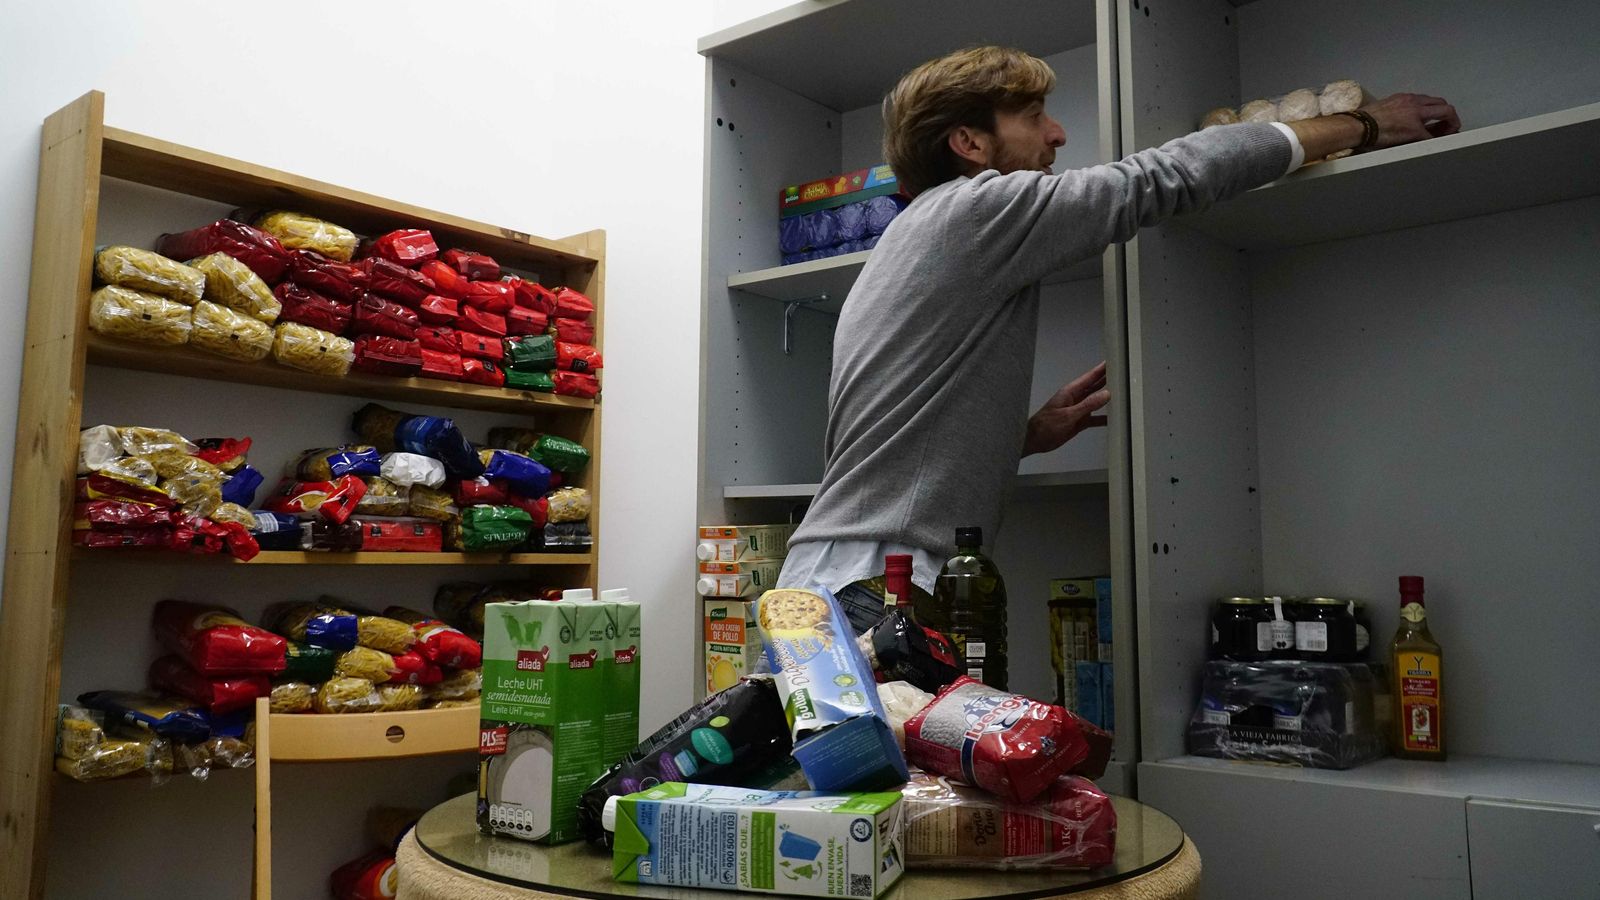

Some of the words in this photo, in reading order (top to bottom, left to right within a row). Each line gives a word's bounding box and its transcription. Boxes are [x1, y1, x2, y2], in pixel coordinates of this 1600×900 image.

[713, 631, 721, 640] DE
[722, 632, 739, 641] POLLO
[517, 656, 542, 671] aliada
[569, 658, 590, 669] aliada
[497, 677, 524, 691] Leche
[526, 678, 543, 691] UHT
[486, 688, 552, 706] semidesnatada
[795, 688, 814, 721] gullón
[491, 704, 508, 715] Leite
[509, 706, 523, 716] UHT
[481, 731, 497, 747] PLS
[1241, 731, 1264, 739] VIEJA
[1266, 733, 1302, 743] FABRICA
[727, 815, 736, 831] 103
[727, 832, 736, 850] 500
[727, 852, 736, 868] 900
[835, 845, 845, 866] VIDA
[738, 851, 750, 889] ¿SABÍAS
[828, 872, 836, 895] BUEN
[836, 867, 845, 895] BUENA
